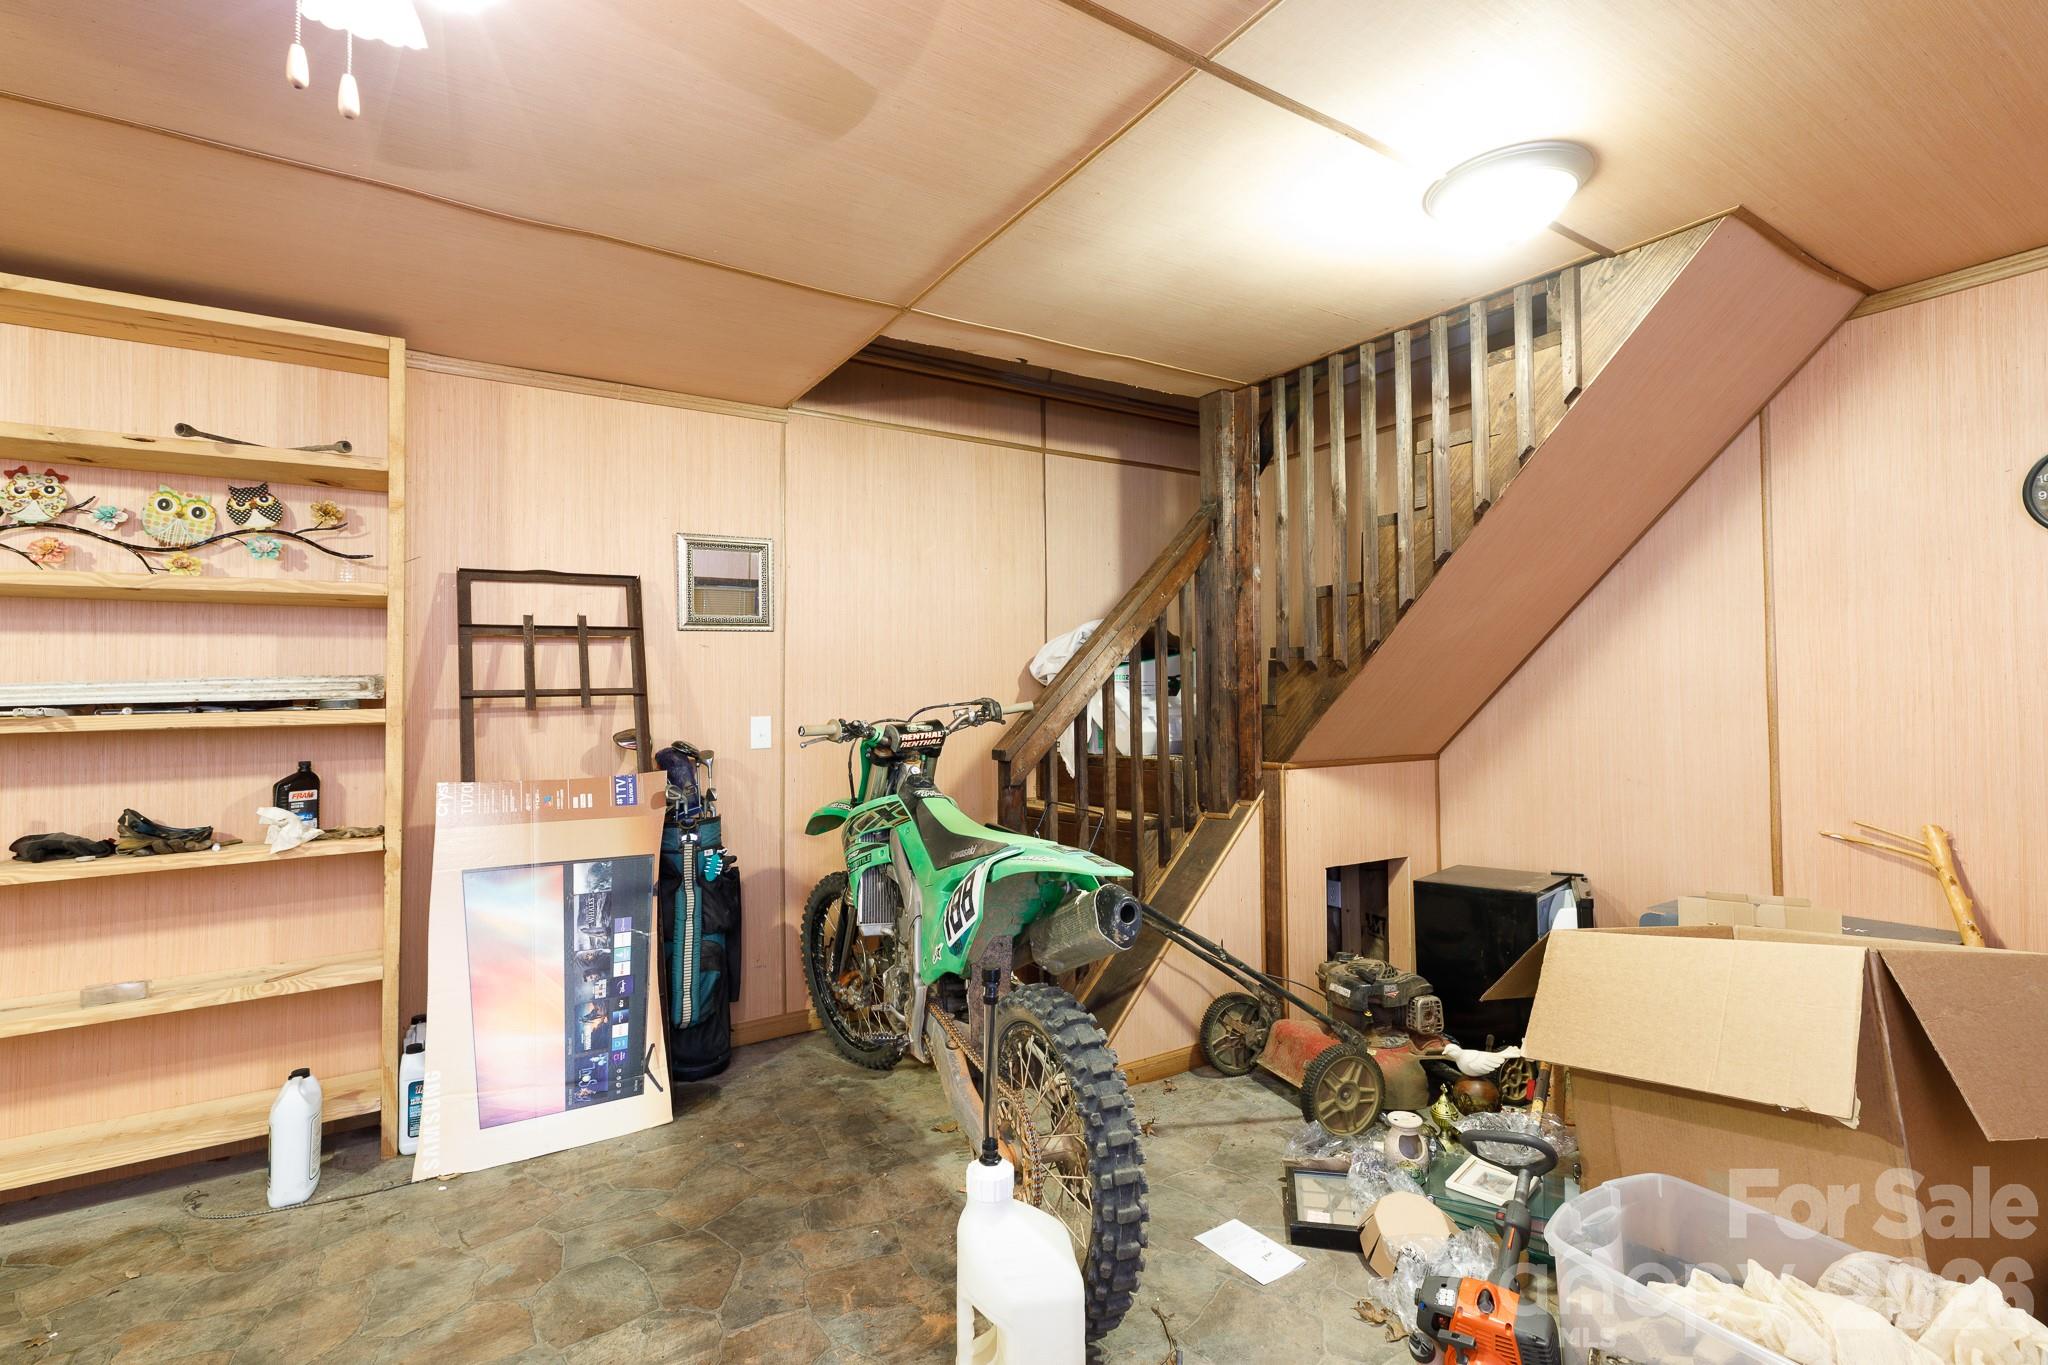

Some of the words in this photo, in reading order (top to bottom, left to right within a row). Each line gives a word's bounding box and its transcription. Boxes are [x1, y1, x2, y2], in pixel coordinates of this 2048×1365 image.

[2038, 490, 2047, 500] 9
[901, 730, 944, 741] RENTHAL
[900, 739, 943, 749] RENTHAL
[615, 778, 627, 794] TV
[292, 790, 315, 800] FRAM
[587, 897, 597, 926] WHALES
[422, 1071, 441, 1171] SAMSUNG
